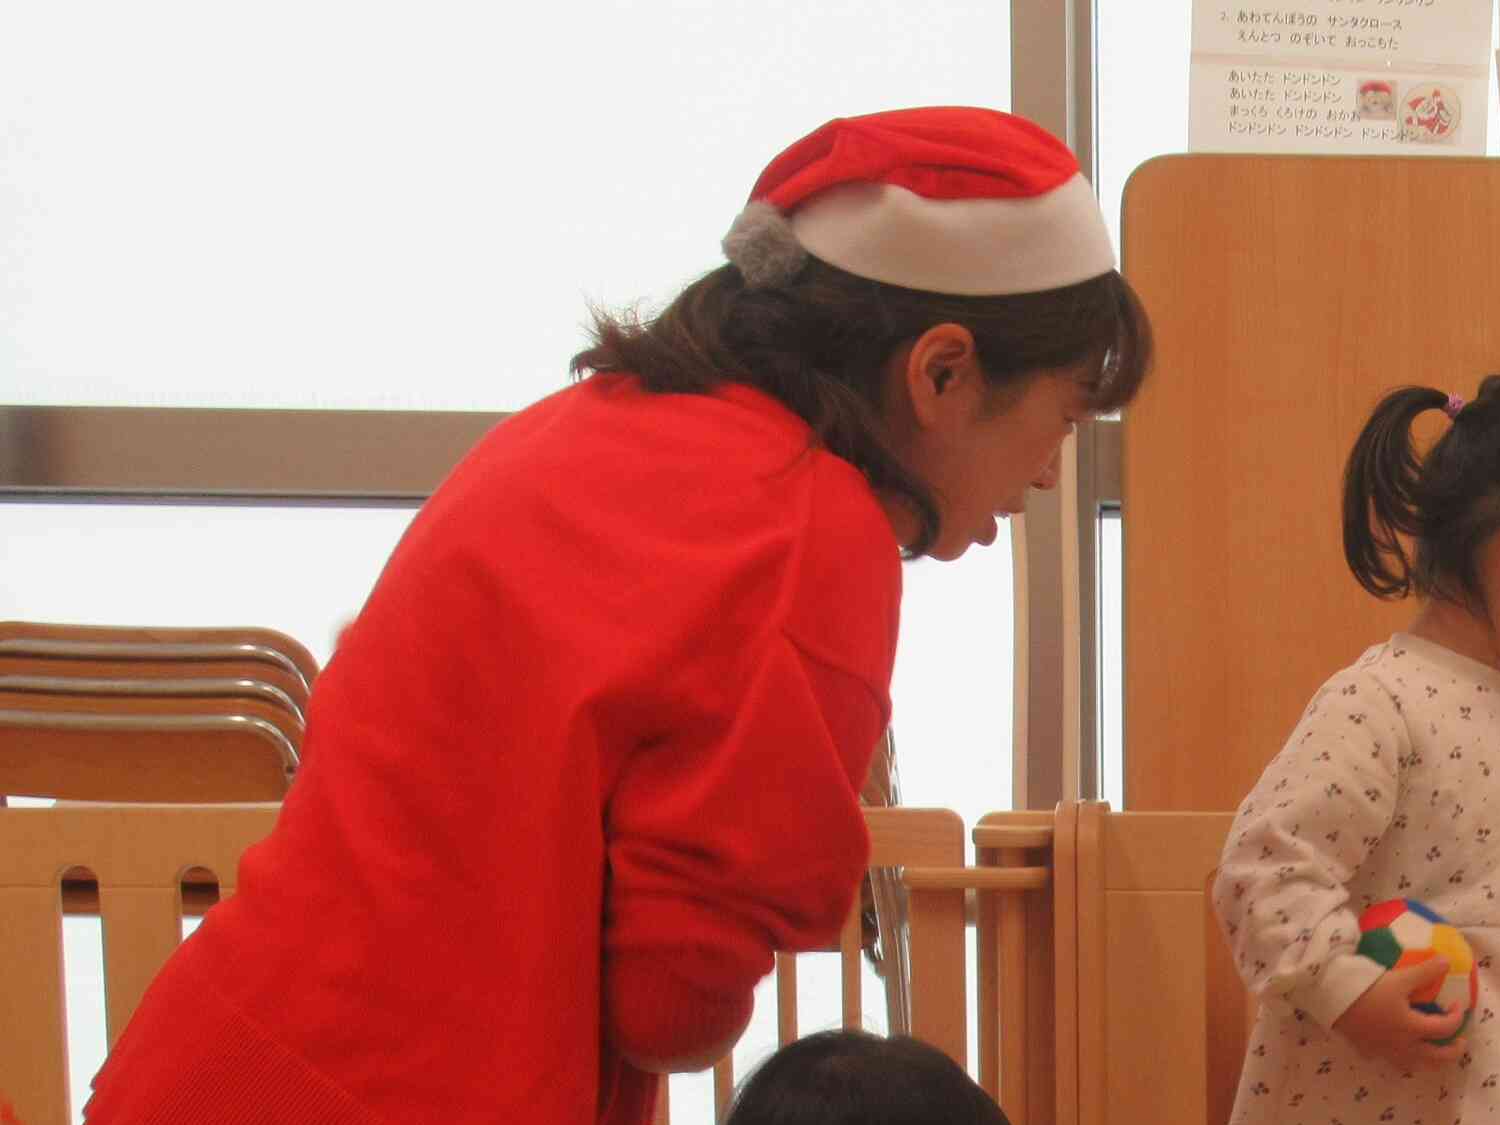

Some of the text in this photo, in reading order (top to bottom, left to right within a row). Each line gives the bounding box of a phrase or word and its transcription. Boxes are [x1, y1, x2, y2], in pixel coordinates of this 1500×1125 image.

[1328, 15, 1402, 30] サンタクロース
[1283, 71, 1341, 86] ドンドンドン
[1284, 89, 1342, 103] ドンドンドン
[1227, 122, 1287, 135] ドンドンドン
[1295, 124, 1352, 138] ドンドンドン
